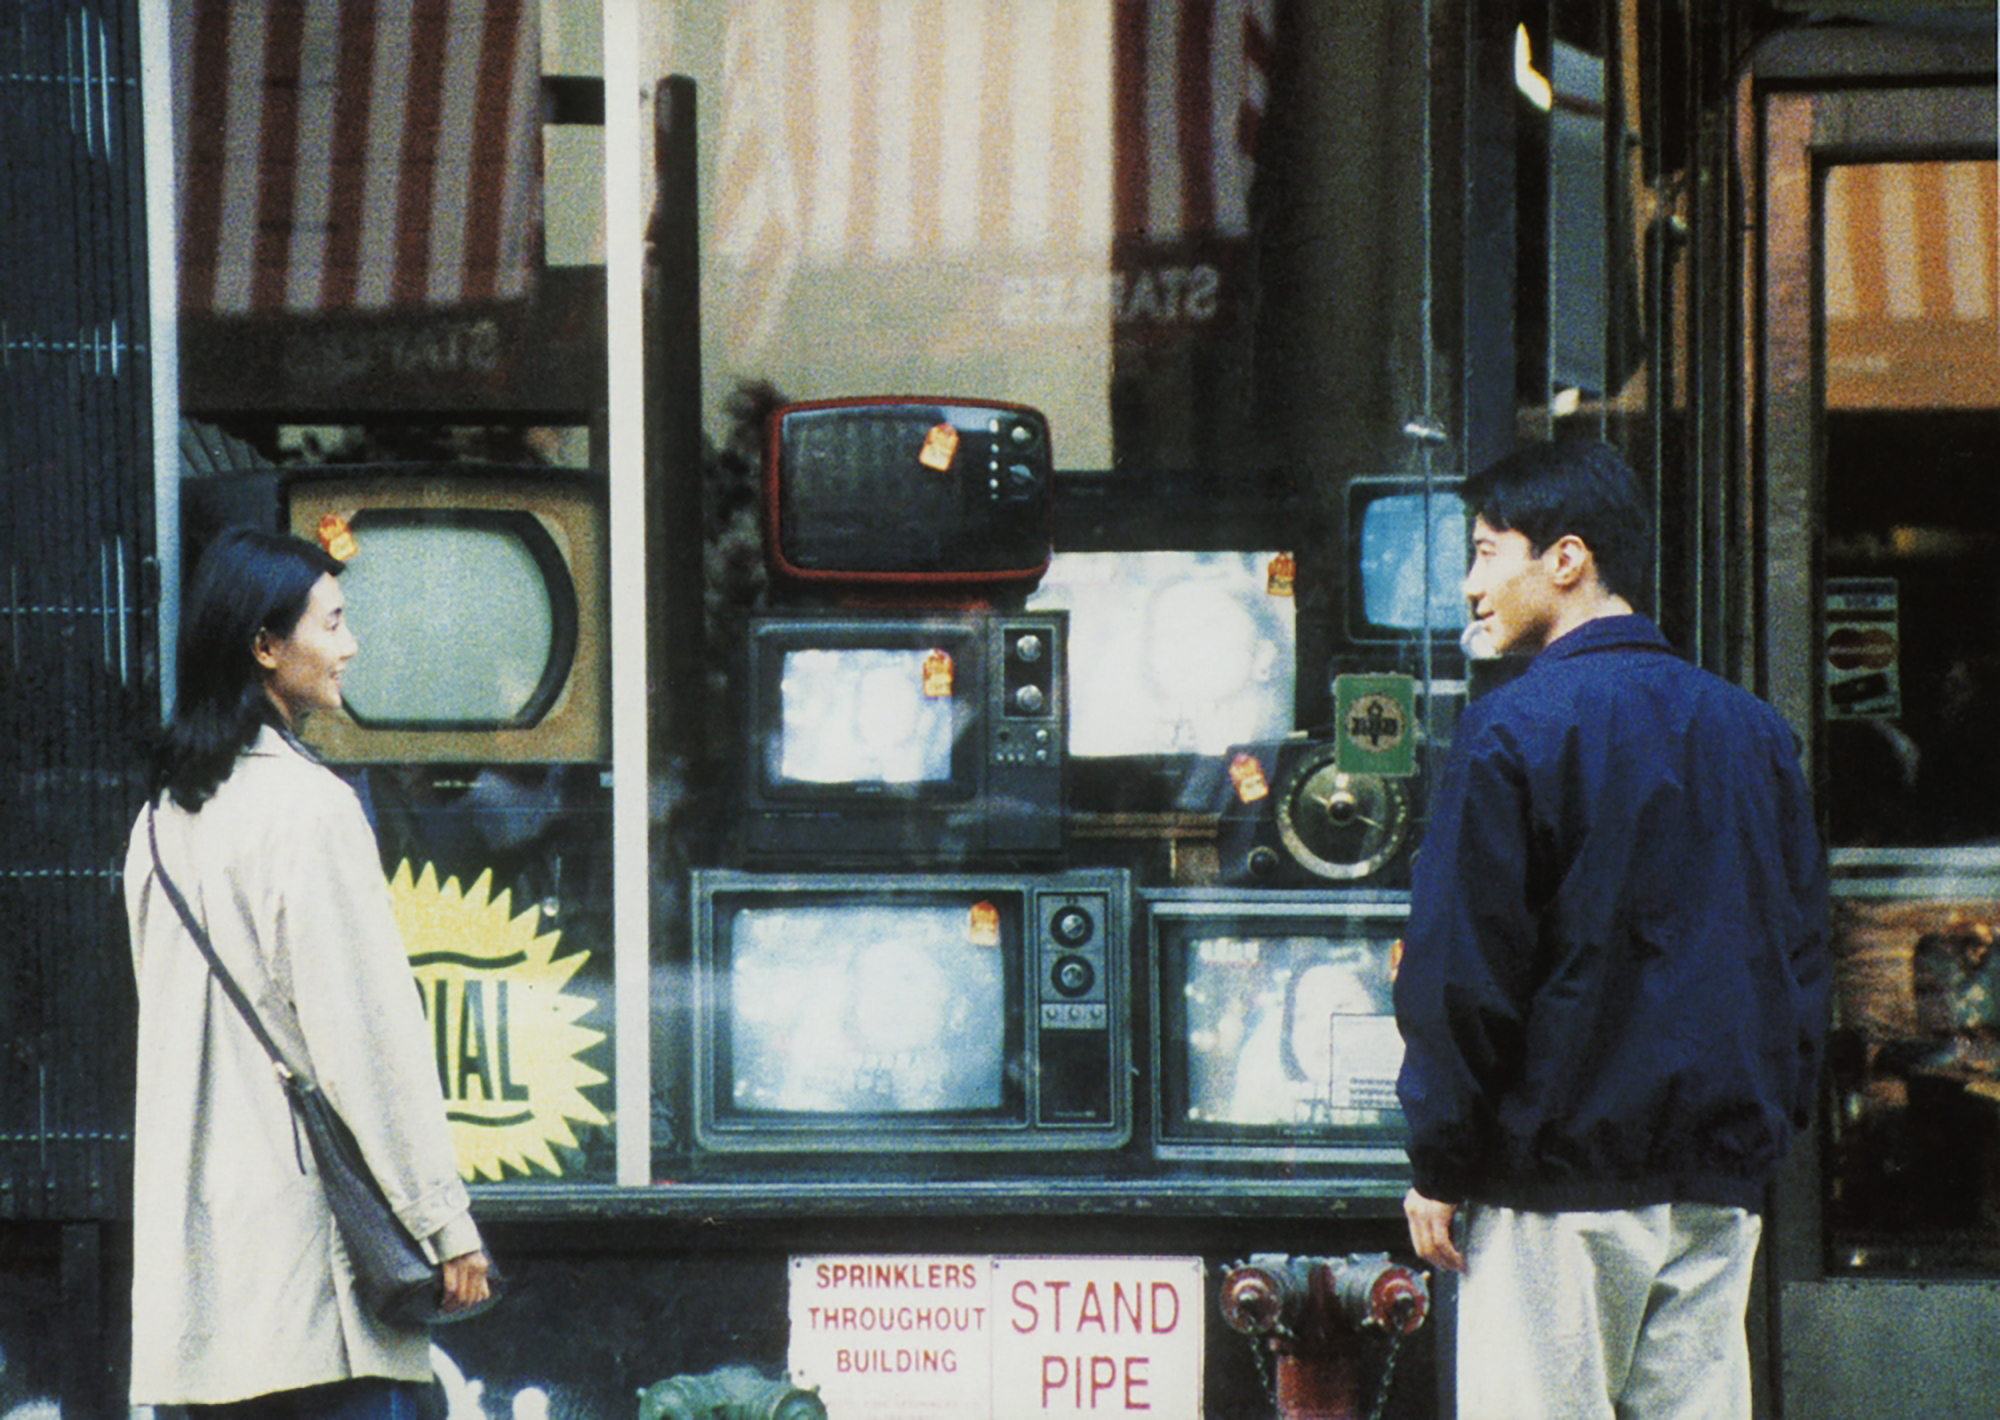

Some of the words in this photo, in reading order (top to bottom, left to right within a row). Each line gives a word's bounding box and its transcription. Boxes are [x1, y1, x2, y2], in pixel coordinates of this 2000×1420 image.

[816, 1264, 977, 1289] SPRINKLERS
[808, 1307, 986, 1331] THROUGHOUT
[1011, 1279, 1180, 1335] STAND
[836, 1349, 957, 1373] BUILDING
[1041, 1355, 1152, 1411] PIPE
